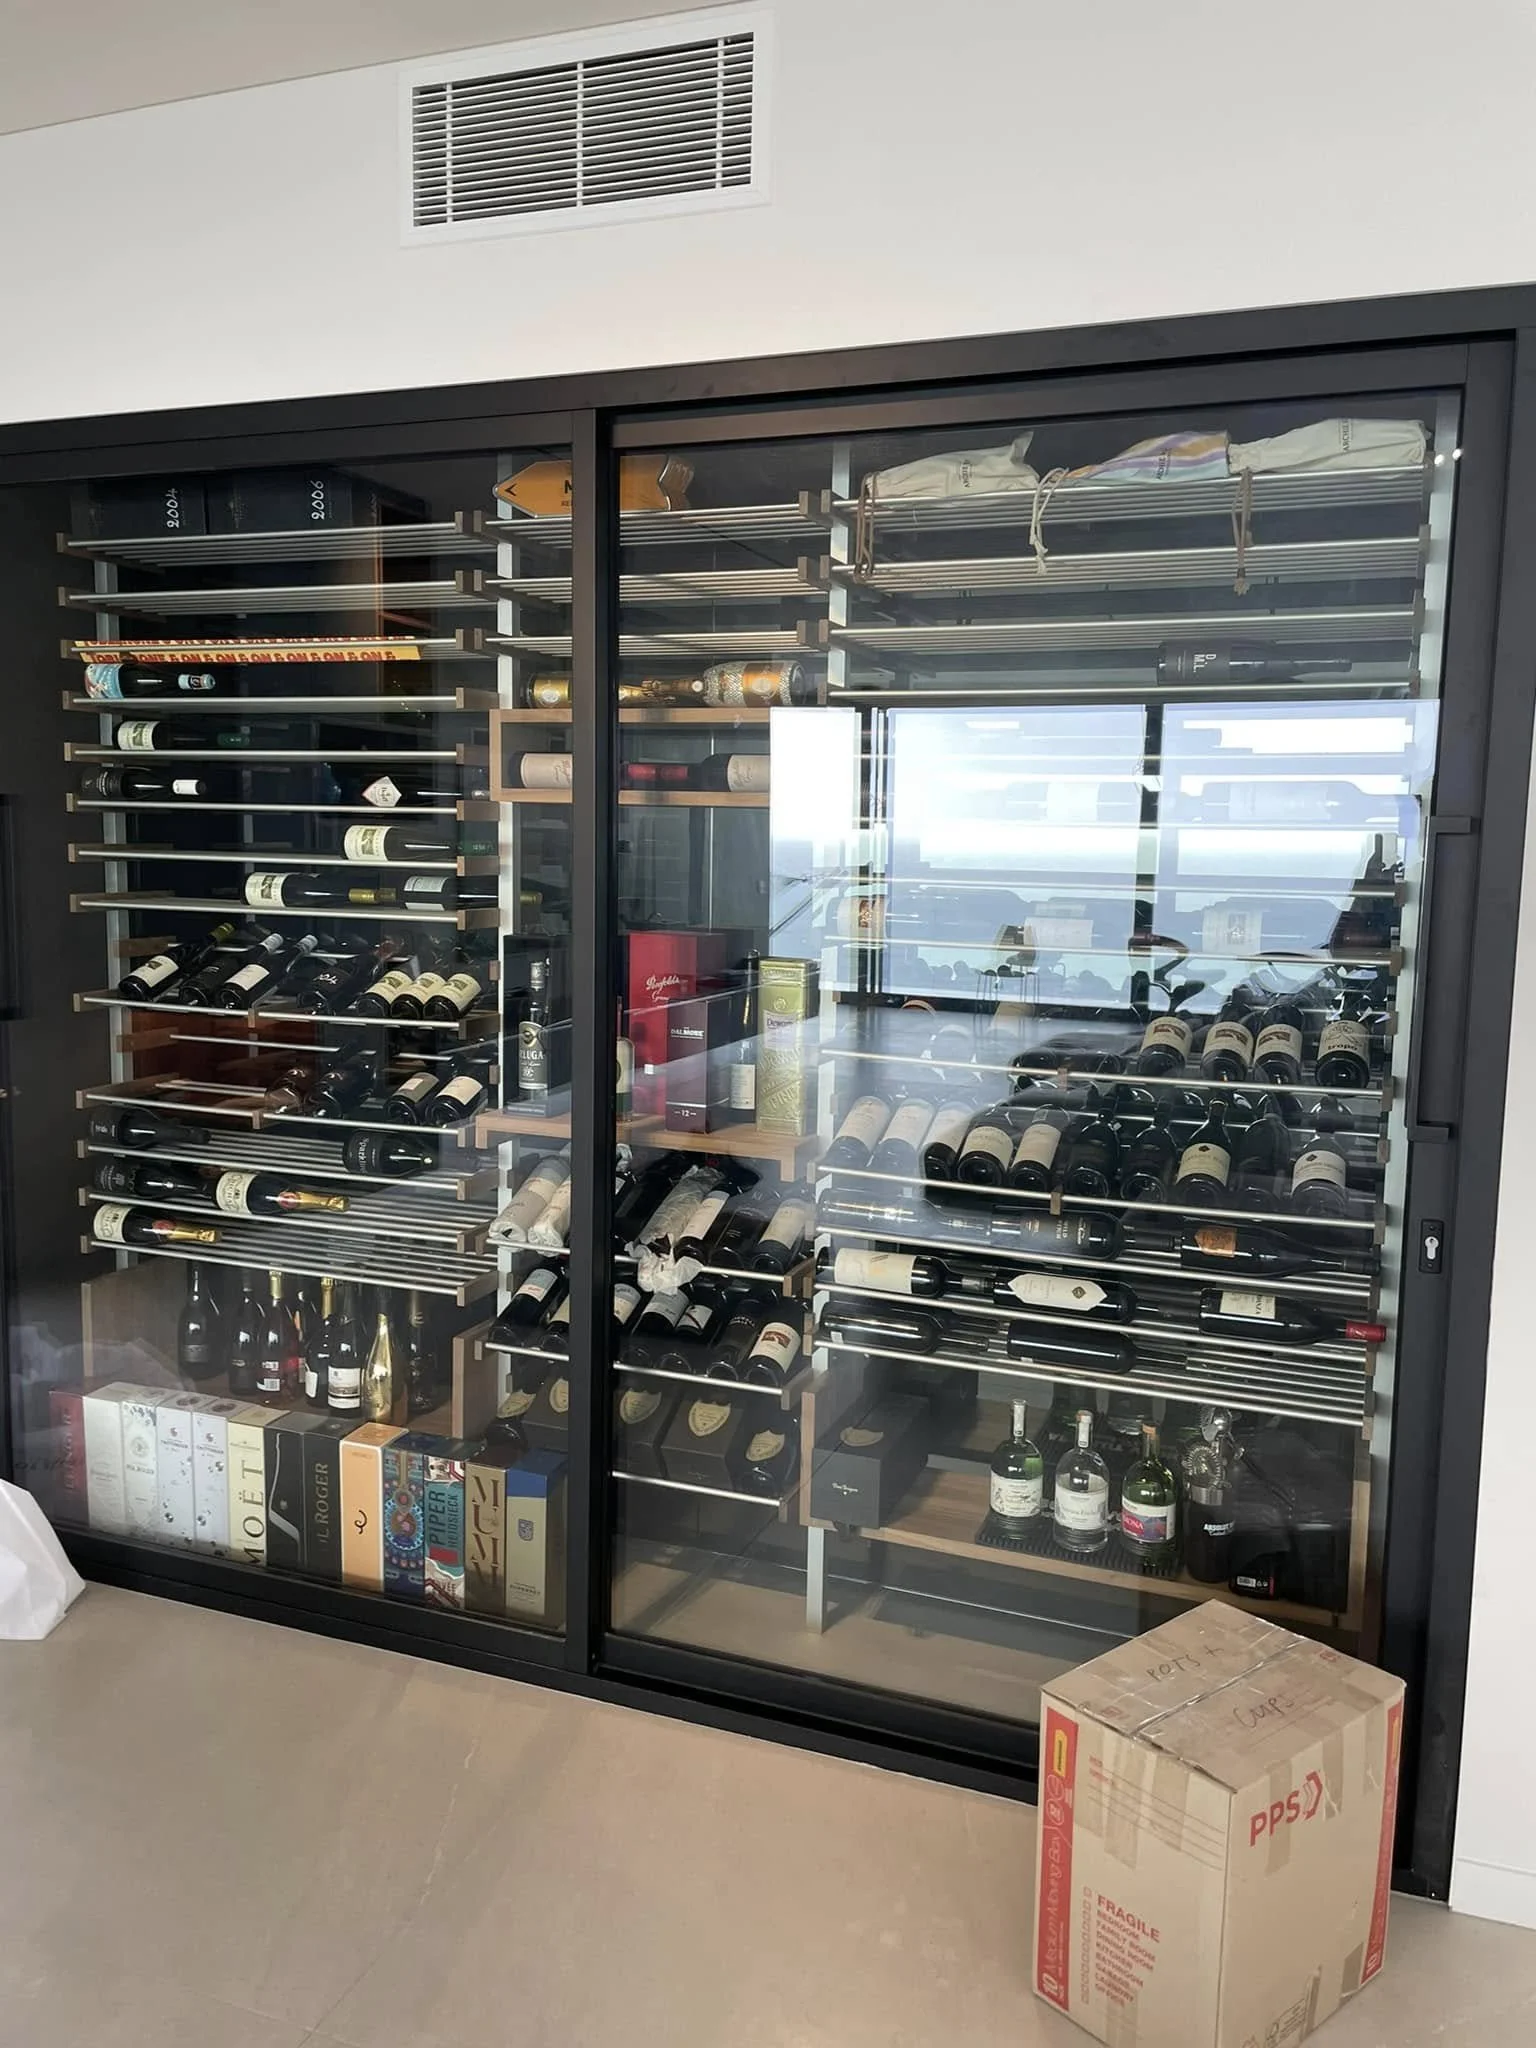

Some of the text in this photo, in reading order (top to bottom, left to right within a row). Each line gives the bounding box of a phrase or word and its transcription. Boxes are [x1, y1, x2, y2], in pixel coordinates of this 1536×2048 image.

[165, 487, 180, 529] 2004
[311, 479, 325, 521] 2006
[238, 1460, 265, 1565] MOËT
[314, 1462, 329, 1523] ROGER
[429, 1489, 446, 1549] PIPER
[1146, 1653, 1201, 1682] POTS
[1249, 1789, 1301, 1848] PPS
[1097, 1894, 1161, 1944] FRAGILE
[1041, 1972, 1059, 1997] 10
